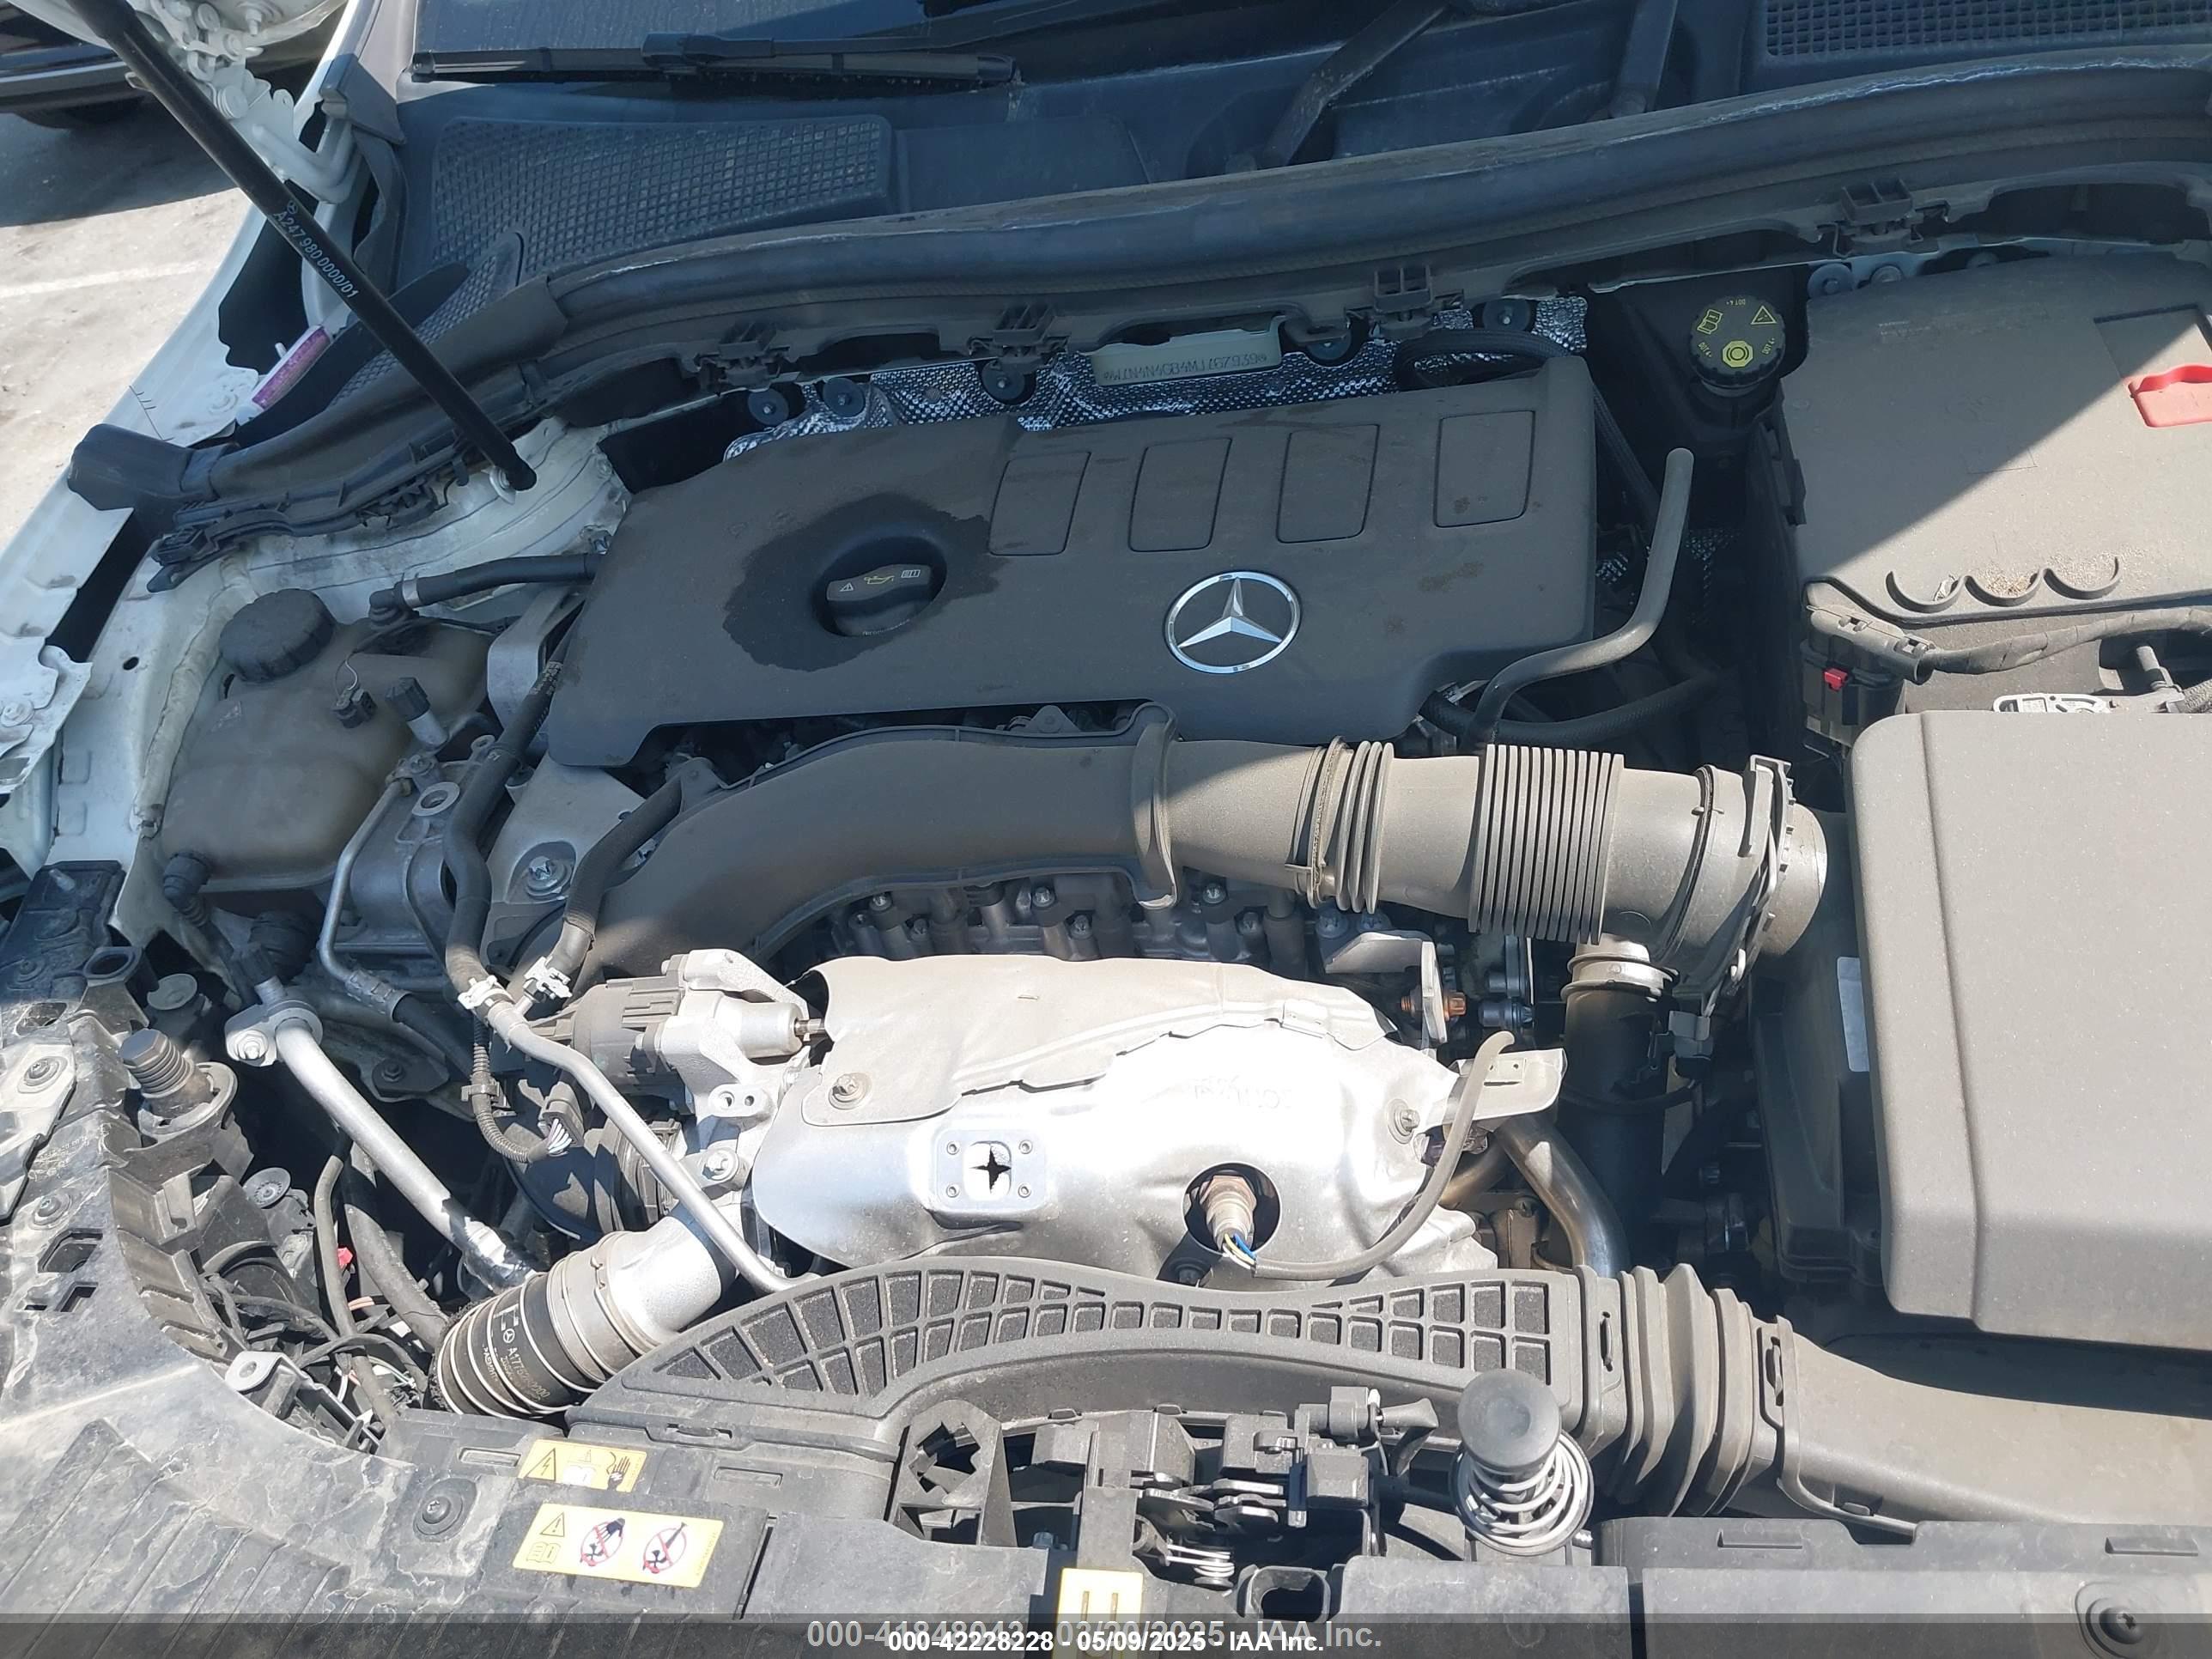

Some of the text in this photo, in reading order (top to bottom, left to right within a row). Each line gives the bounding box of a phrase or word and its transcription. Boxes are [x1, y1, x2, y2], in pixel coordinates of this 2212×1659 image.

[273, 211, 359, 298] A247 980 0000/01
